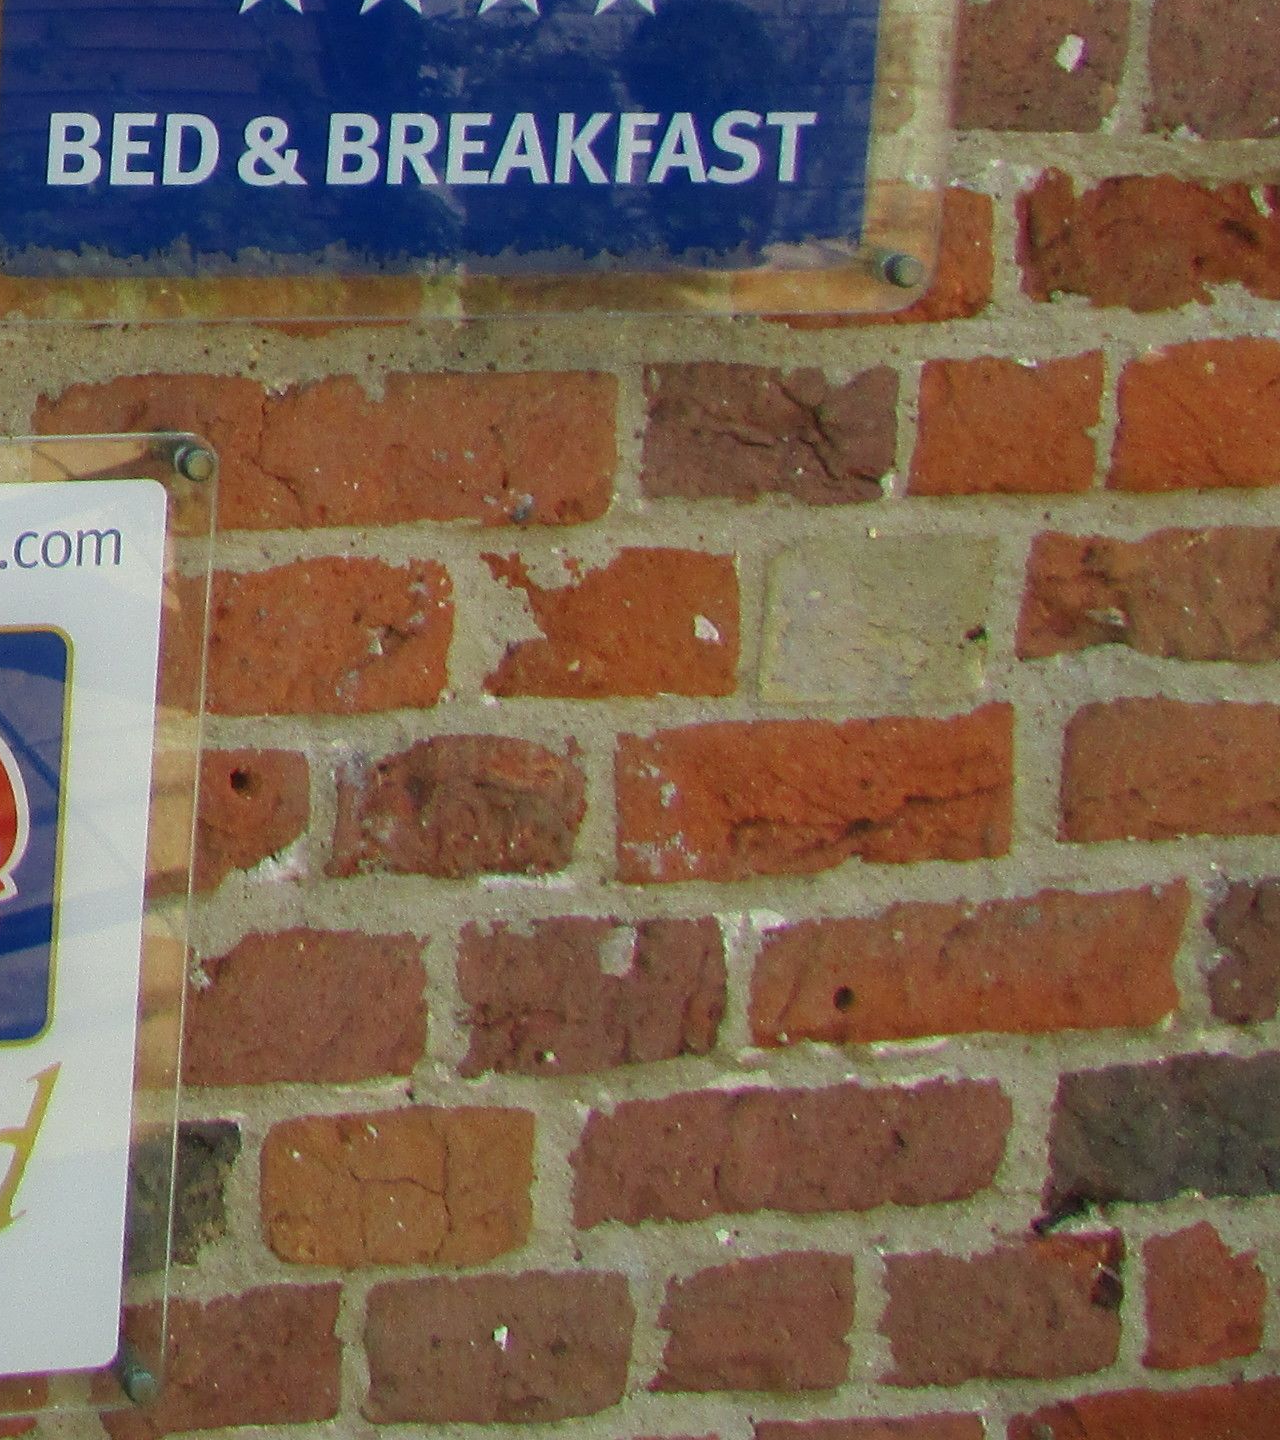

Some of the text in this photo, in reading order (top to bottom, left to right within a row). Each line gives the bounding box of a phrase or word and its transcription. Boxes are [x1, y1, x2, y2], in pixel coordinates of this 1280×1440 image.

[46, 110, 817, 187] BED & BREAKFAST
